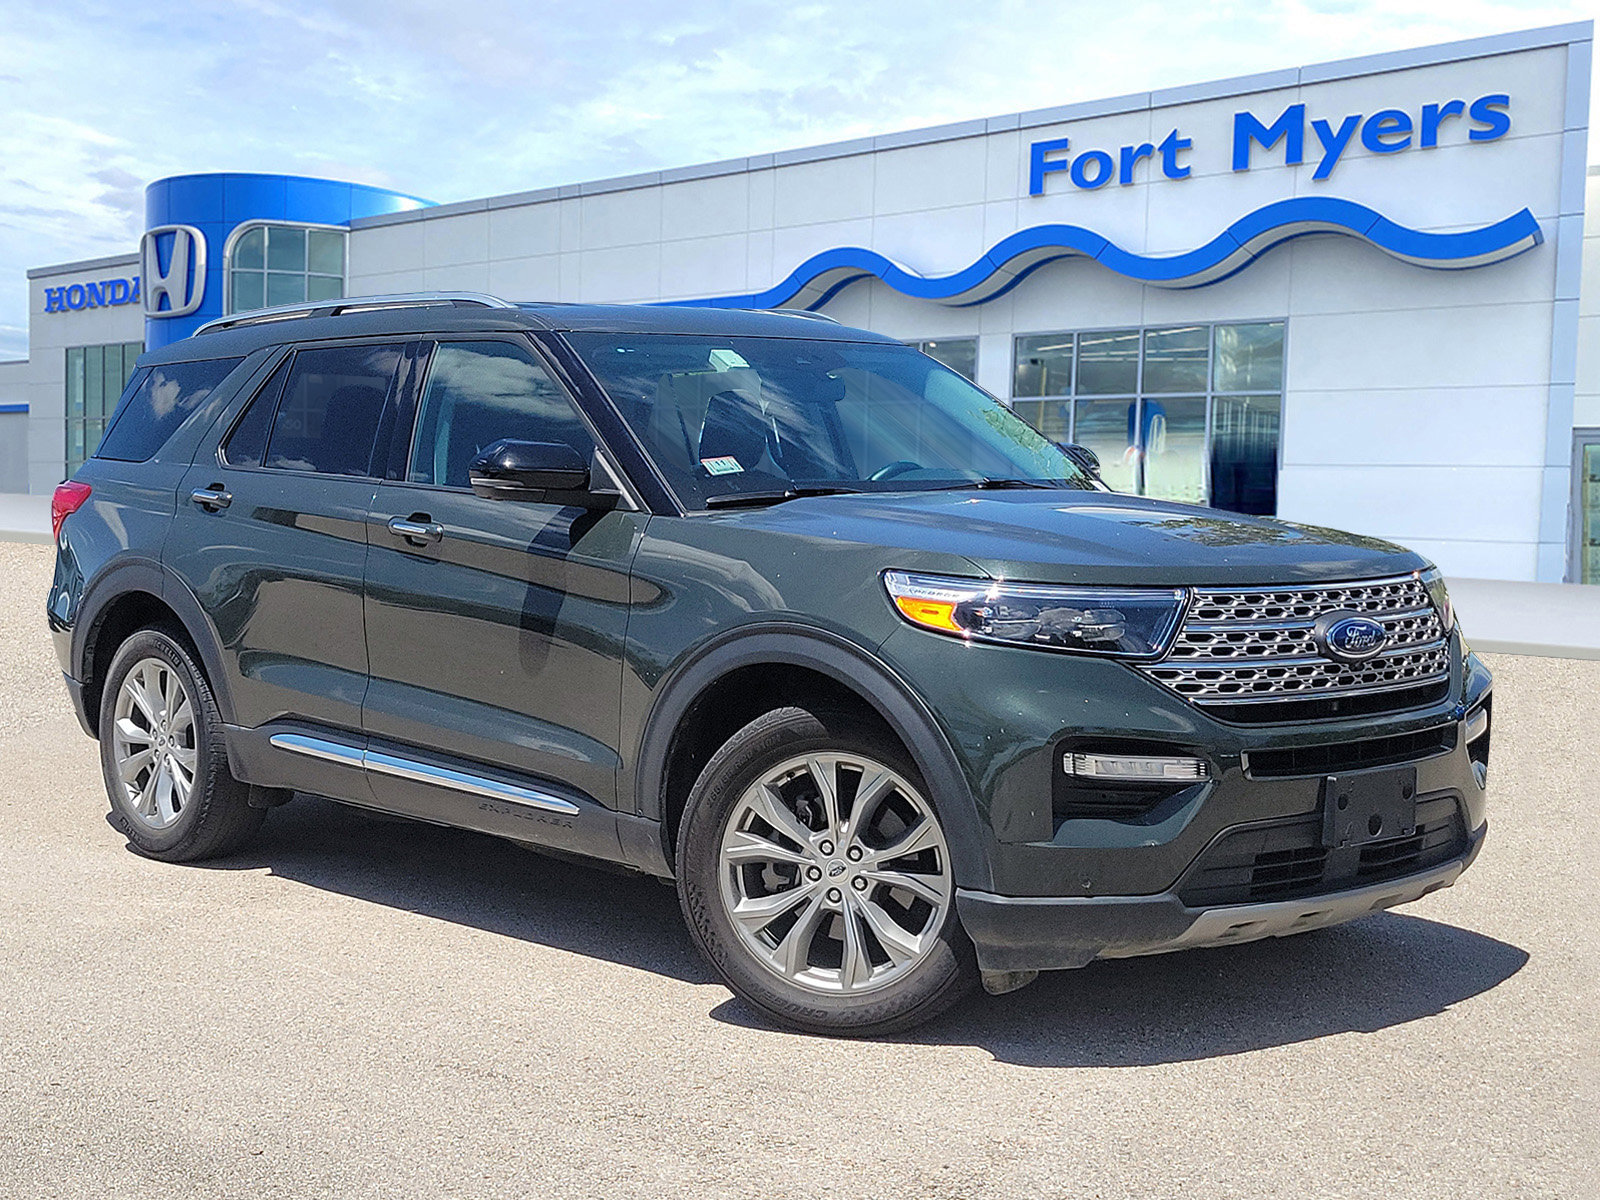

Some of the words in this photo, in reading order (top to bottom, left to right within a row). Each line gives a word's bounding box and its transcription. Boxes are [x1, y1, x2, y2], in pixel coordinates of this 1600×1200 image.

[1028, 128, 1193, 197] Fort
[1232, 93, 1512, 182] Myers
[1344, 625, 1377, 649] Ford
